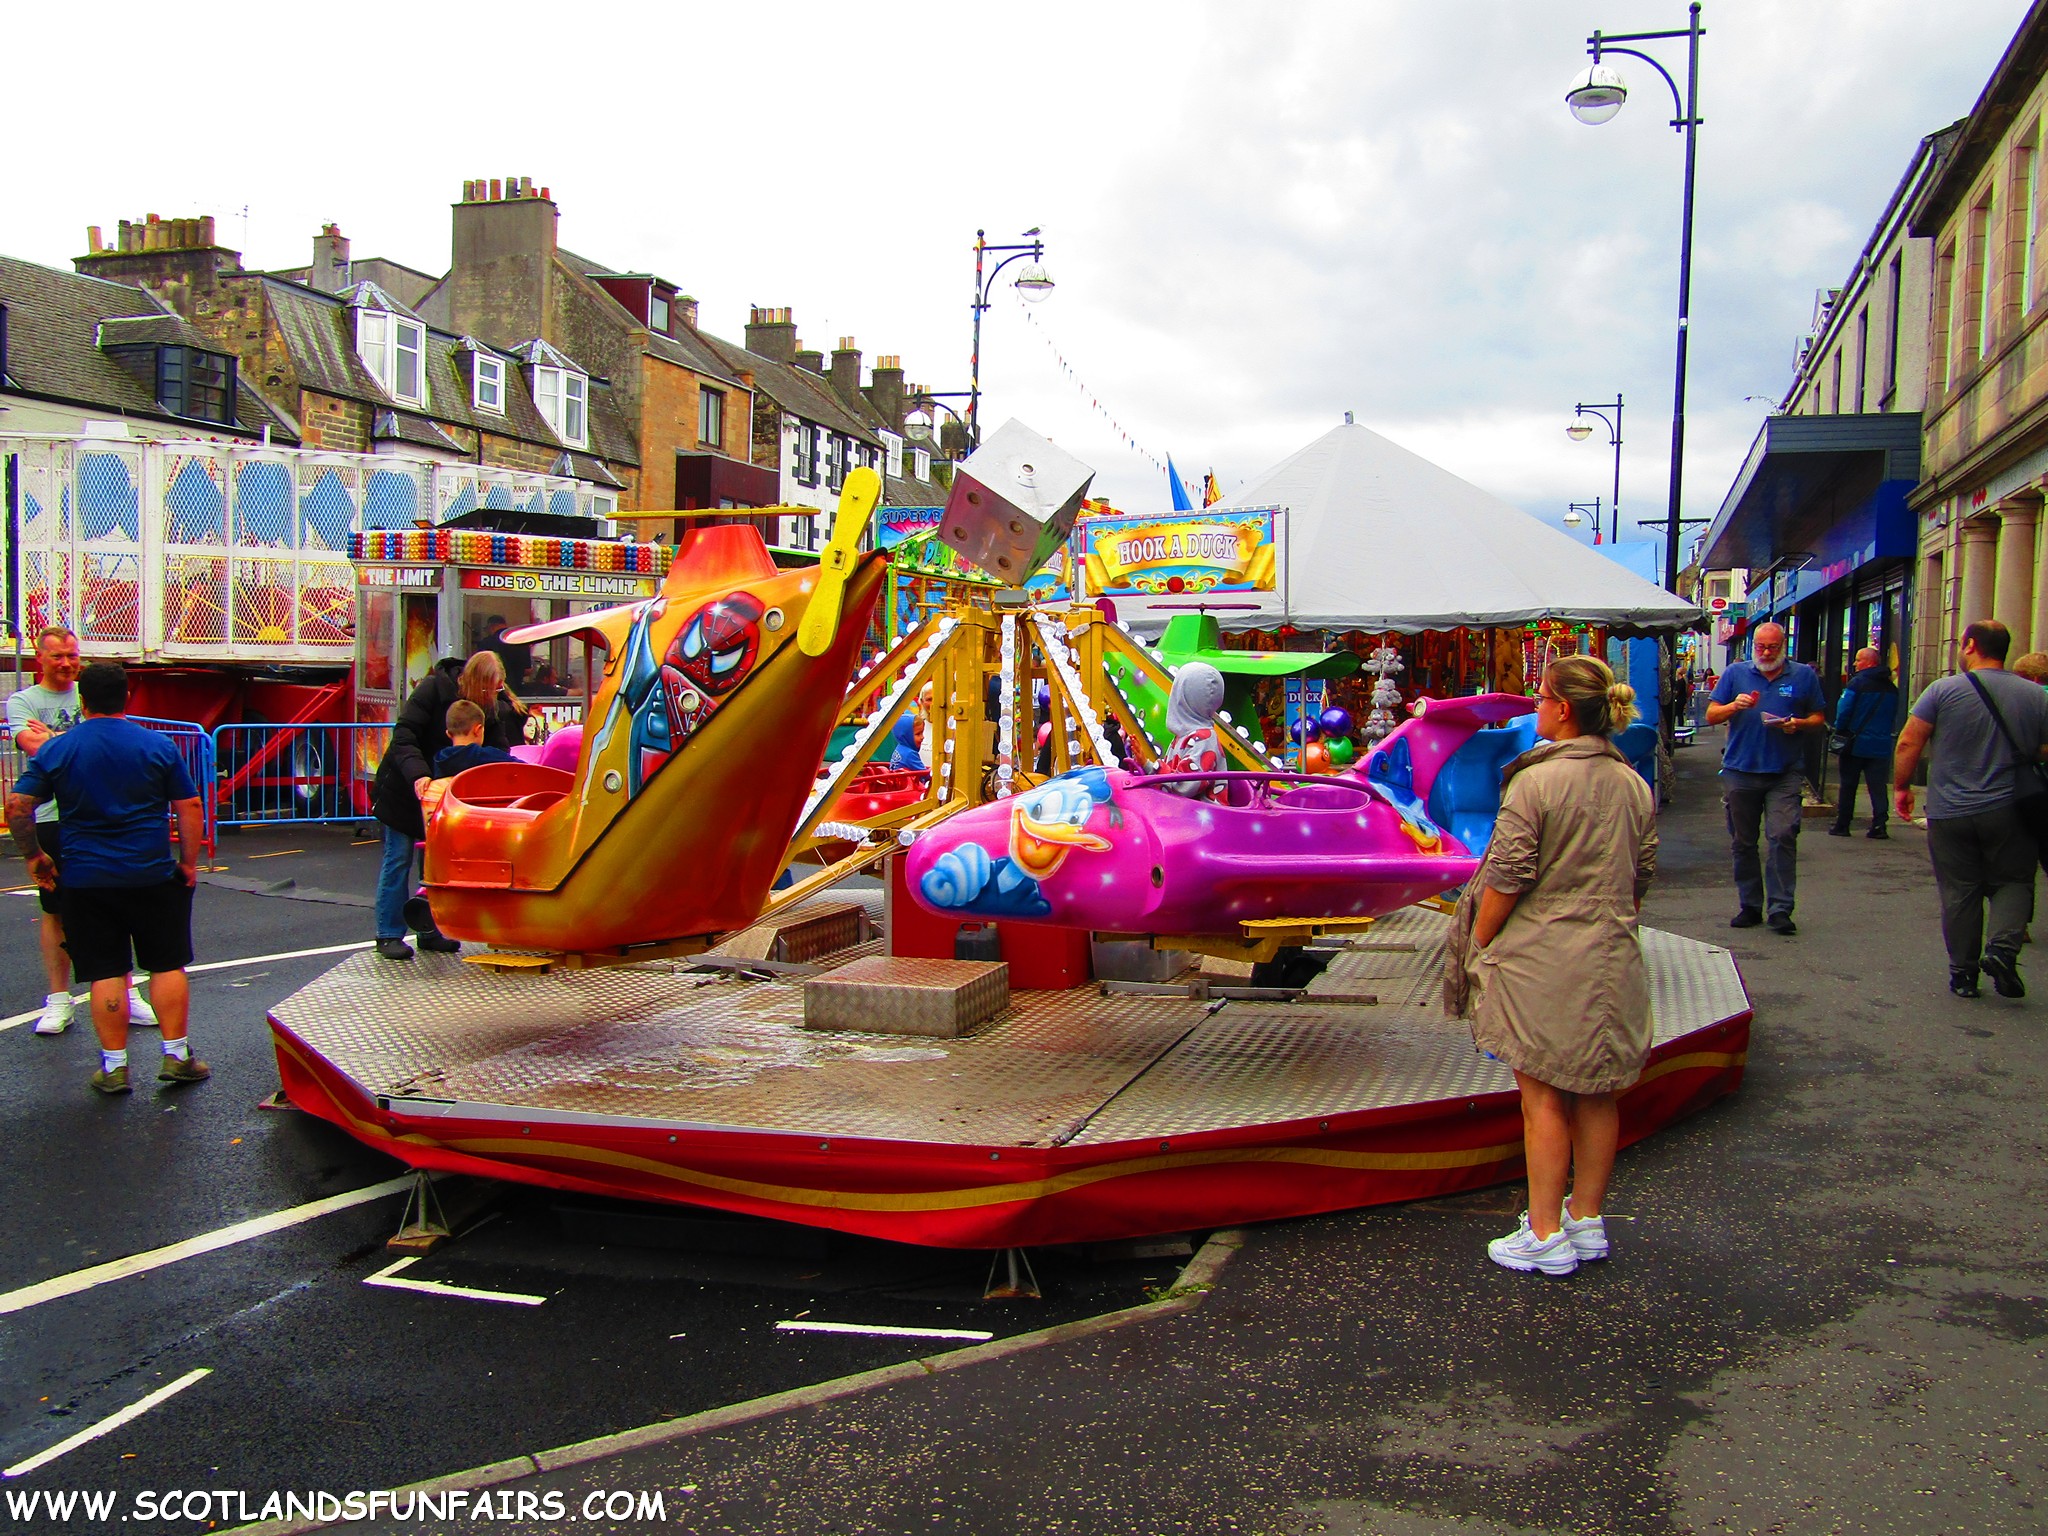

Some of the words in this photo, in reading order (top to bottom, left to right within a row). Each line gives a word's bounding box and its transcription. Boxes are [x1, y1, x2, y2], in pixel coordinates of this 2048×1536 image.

[880, 510, 930, 524] SUPER
[1118, 536, 1166, 565] HOOK
[1169, 535, 1183, 558] A
[1186, 534, 1237, 559] DUCK
[367, 568, 394, 586] THE
[396, 569, 435, 586] LIMIT
[480, 575, 513, 588] RIDE
[517, 576, 536, 589] TO
[540, 573, 580, 592] THE
[584, 577, 637, 594] LIMIT
